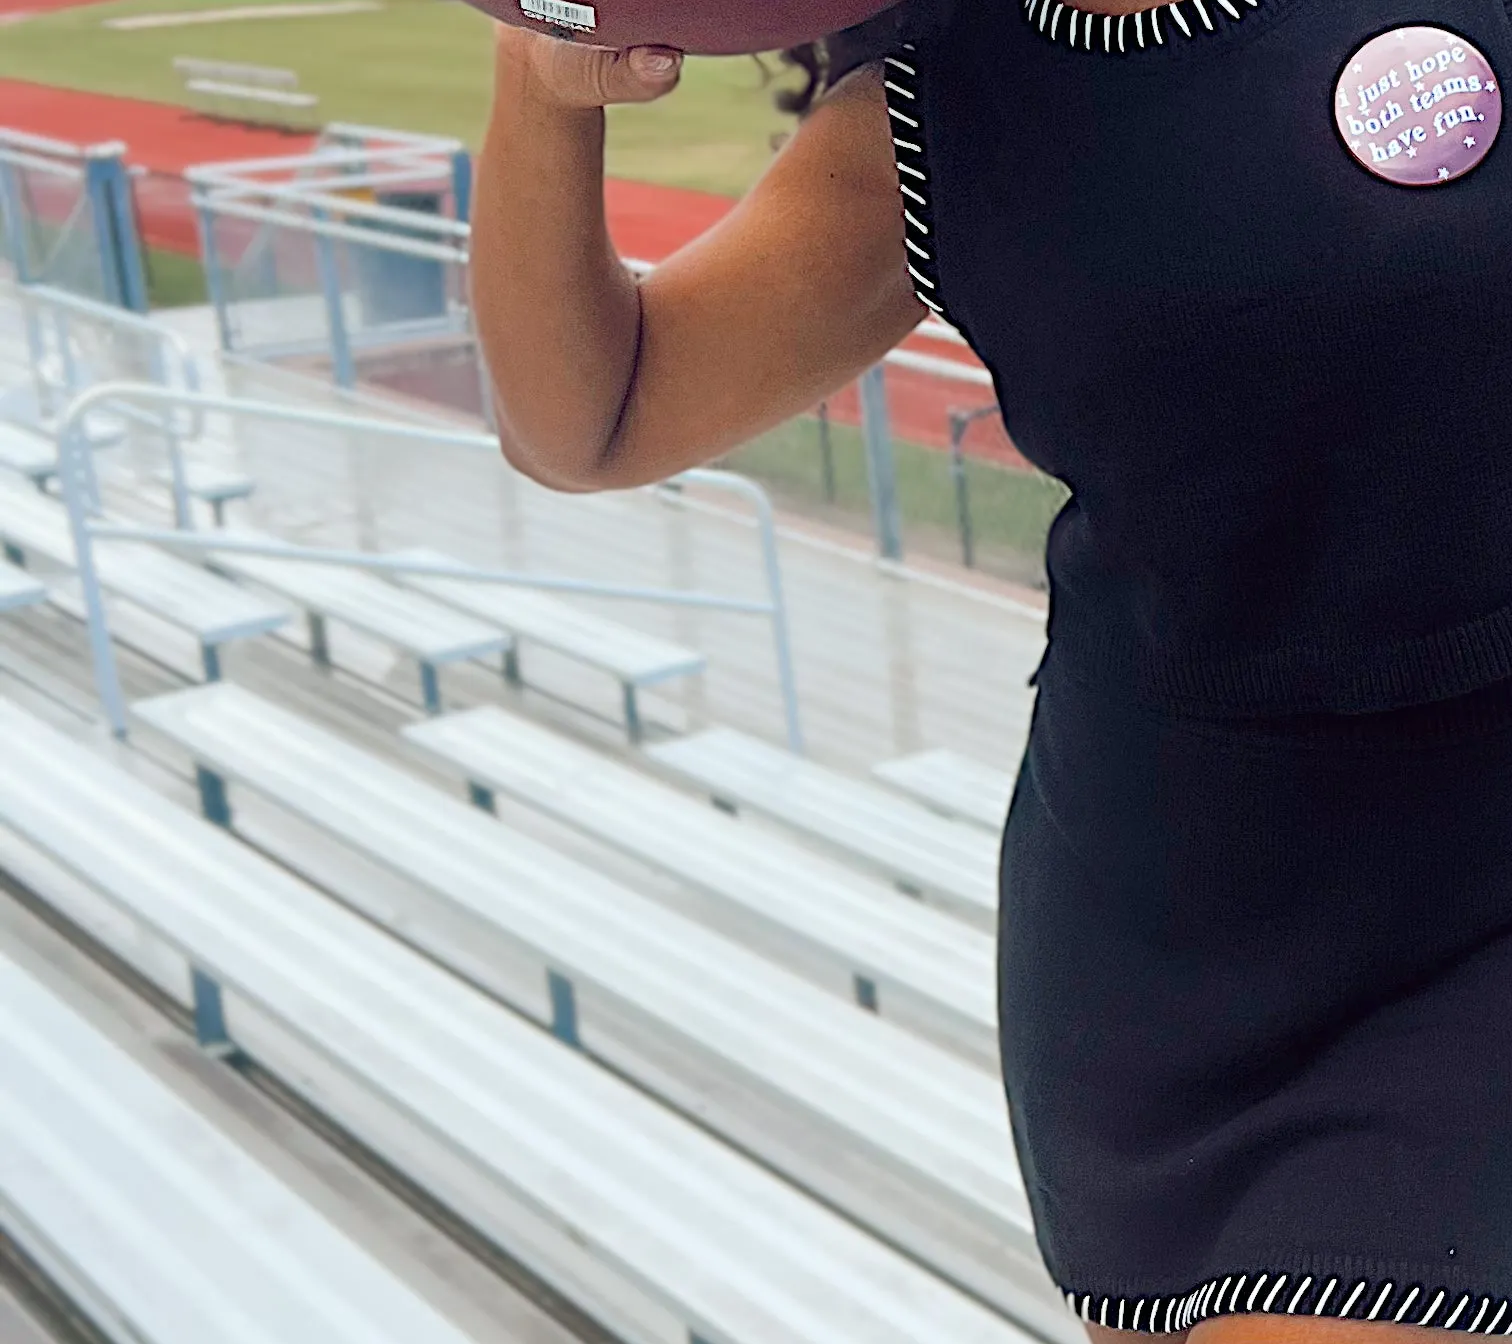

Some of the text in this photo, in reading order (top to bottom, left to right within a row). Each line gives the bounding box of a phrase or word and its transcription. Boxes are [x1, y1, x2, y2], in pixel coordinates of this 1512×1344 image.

[1346, 74, 1482, 135] both teams
[1358, 69, 1401, 110] just
[1405, 46, 1467, 82] hope
[1369, 105, 1485, 162] have fun.
